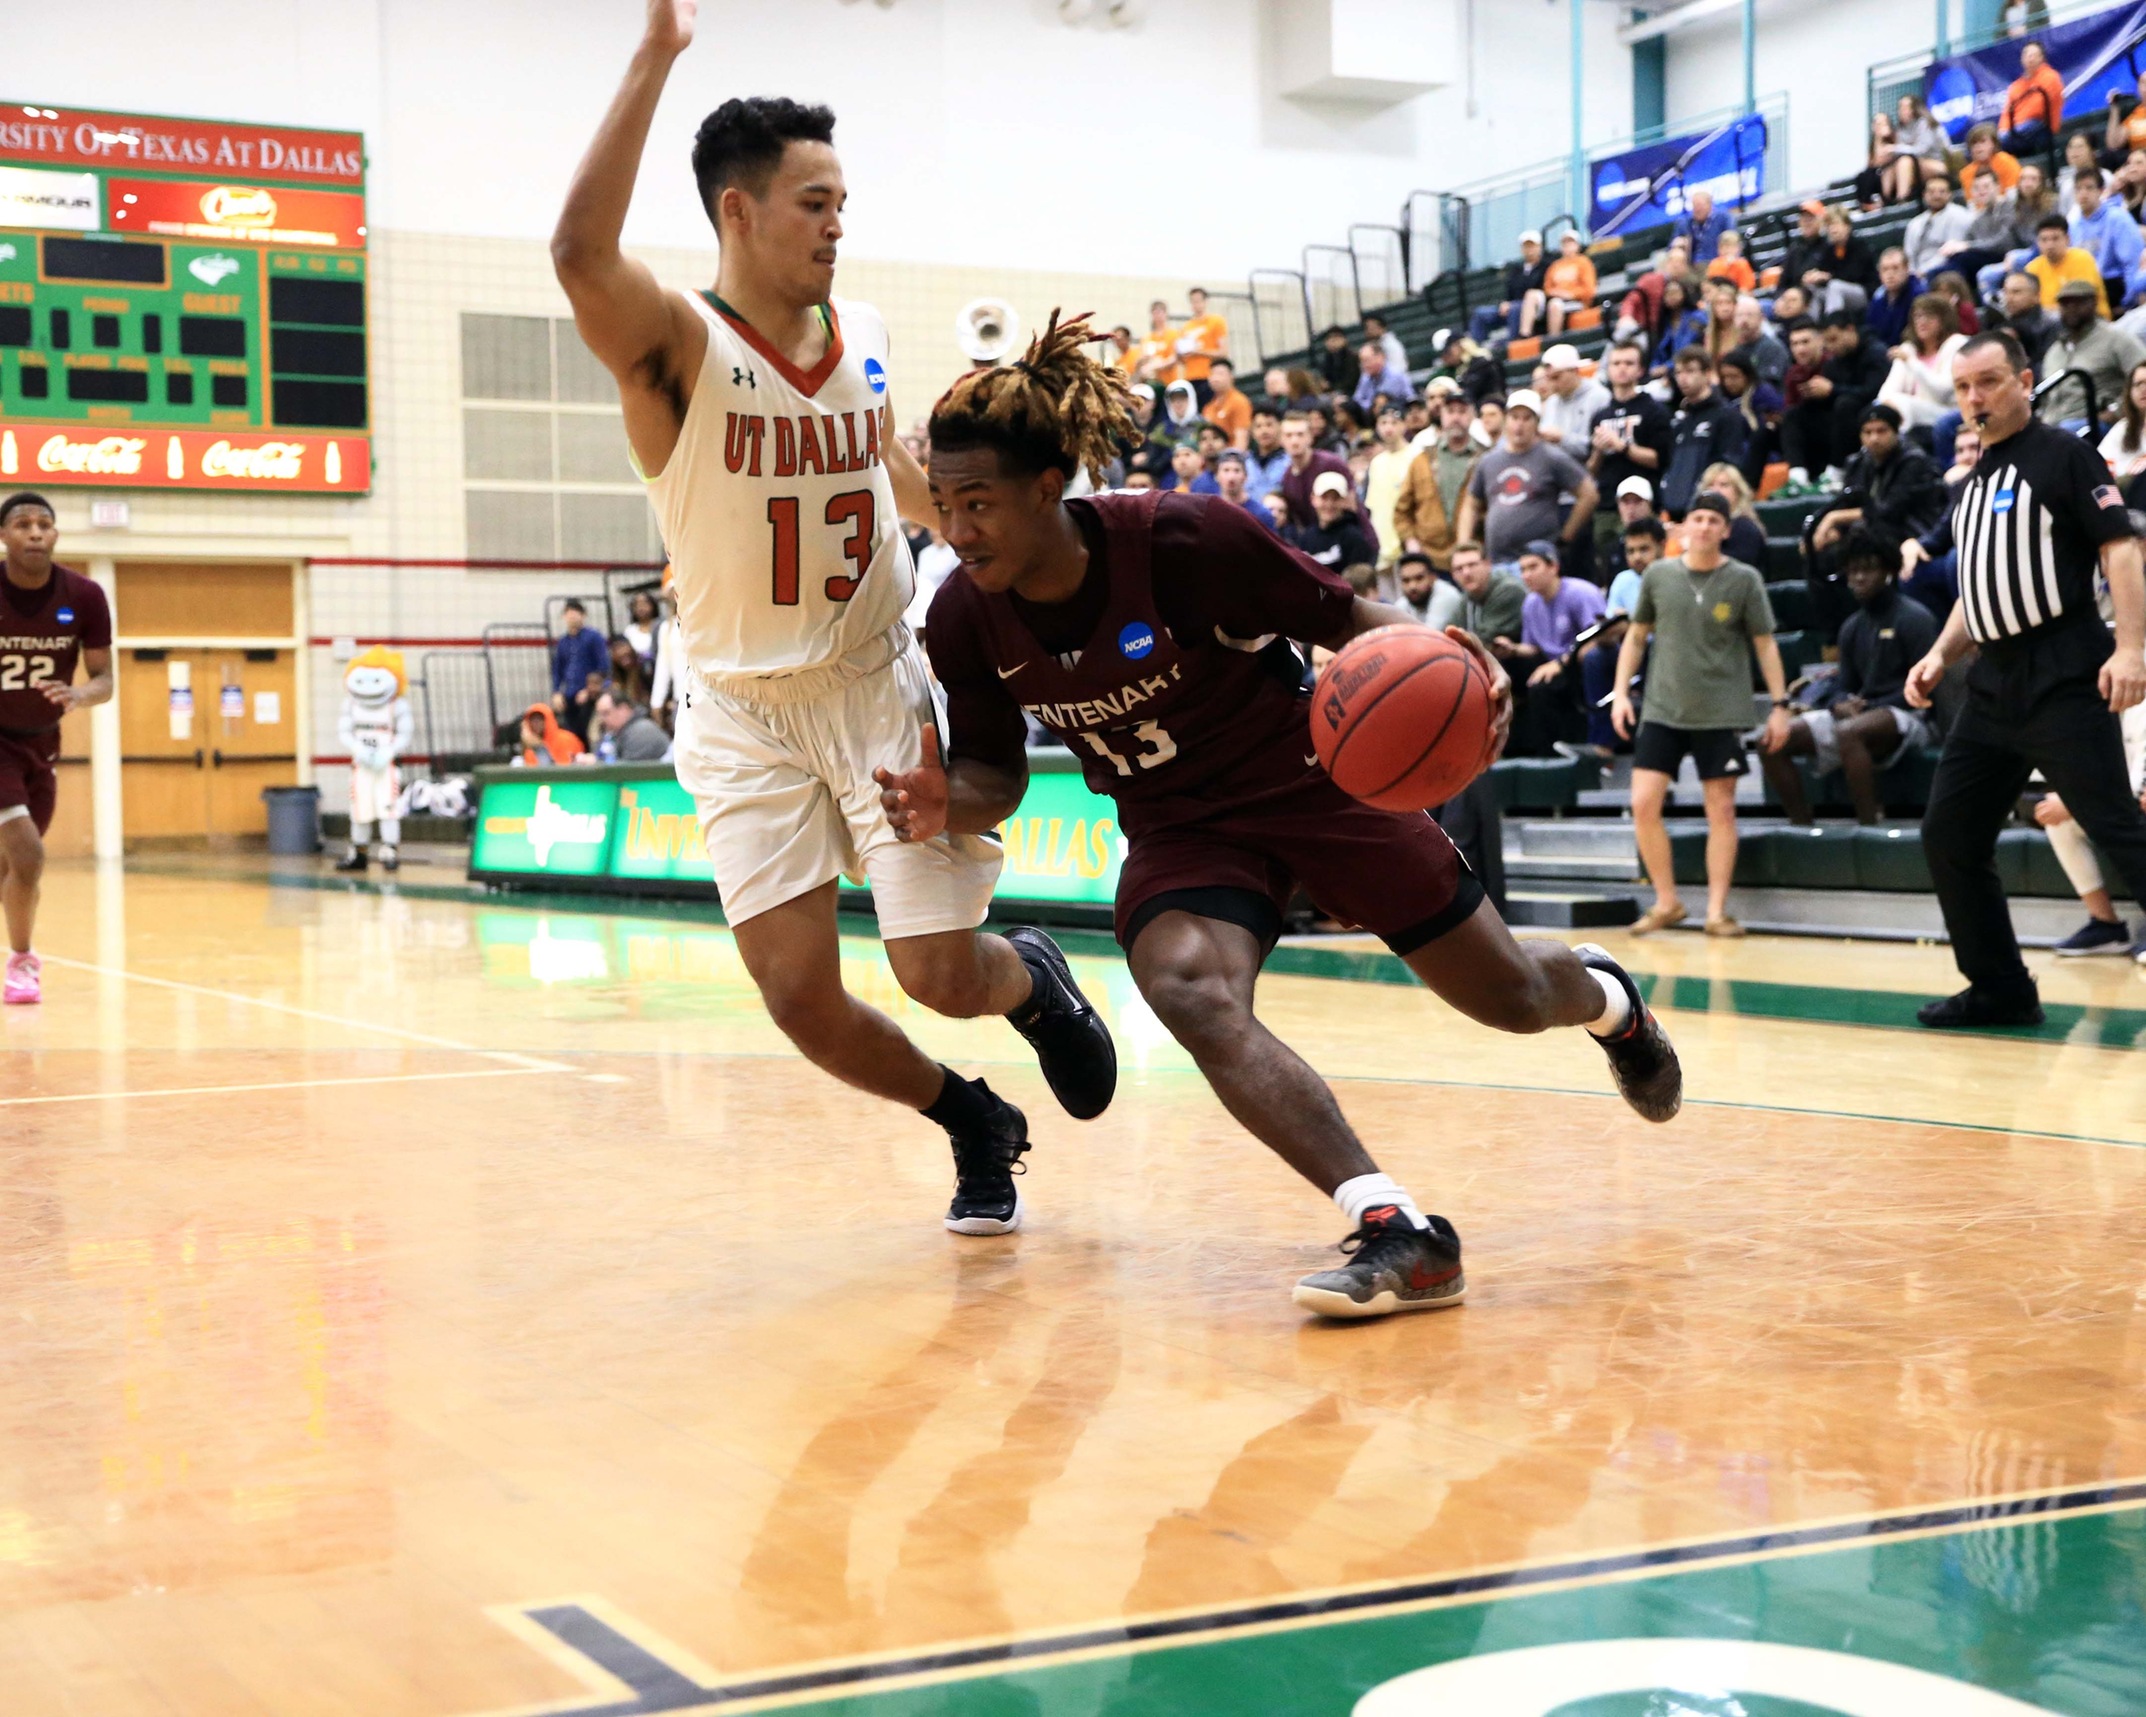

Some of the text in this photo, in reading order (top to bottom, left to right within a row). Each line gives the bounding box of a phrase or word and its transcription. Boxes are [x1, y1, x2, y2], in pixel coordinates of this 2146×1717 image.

[120, 126, 211, 164] TEXAS
[214, 135, 256, 168] AT
[259, 137, 361, 177] DALLAS
[724, 406, 884, 477] UT DALLA
[767, 488, 875, 606] 13
[0, 654, 55, 691] 22
[1124, 634, 1153, 653] NCAA
[1022, 662, 1182, 729] ENTENARY
[1078, 718, 1178, 777] 13
